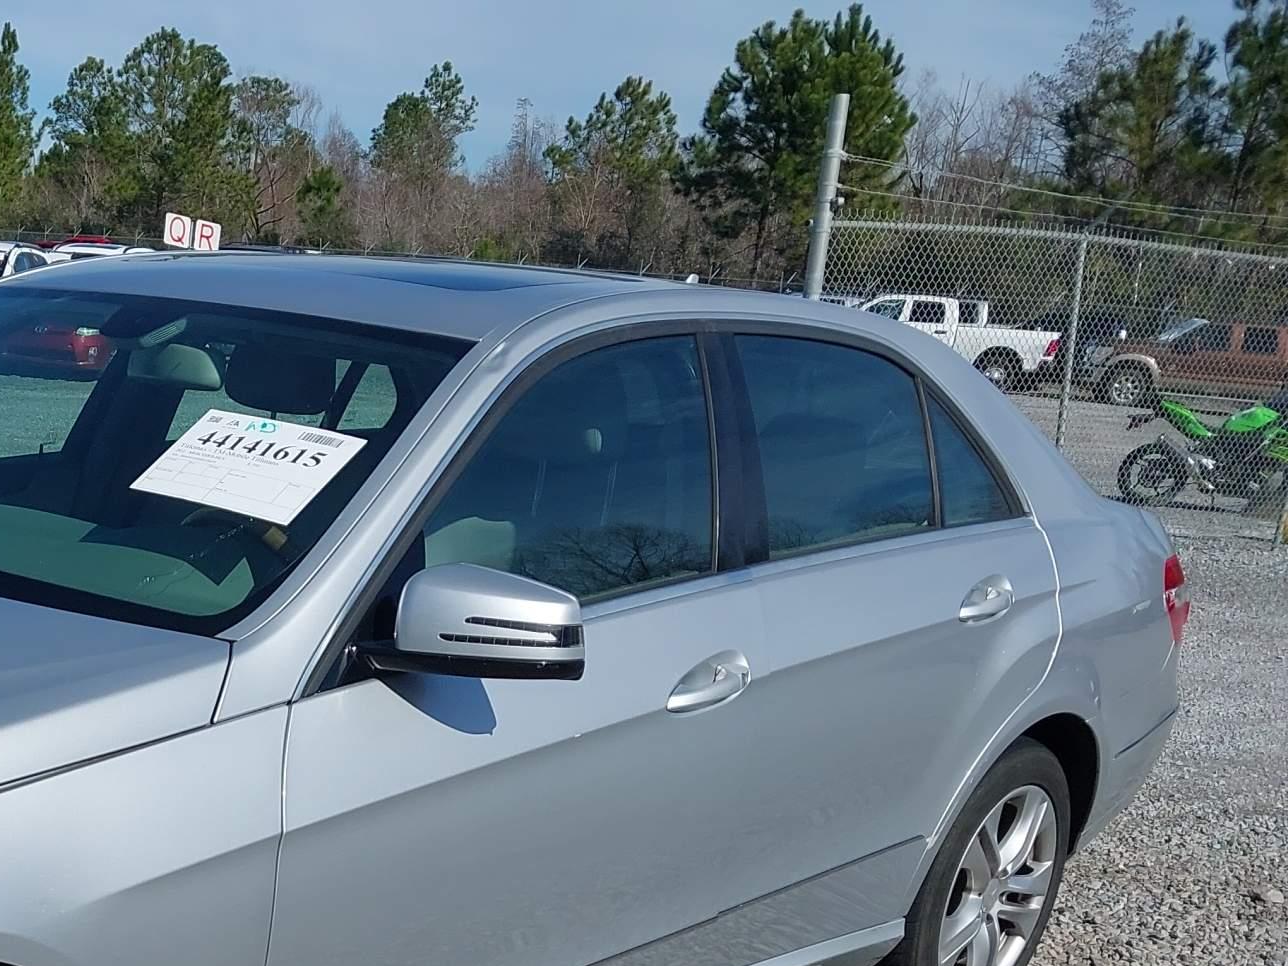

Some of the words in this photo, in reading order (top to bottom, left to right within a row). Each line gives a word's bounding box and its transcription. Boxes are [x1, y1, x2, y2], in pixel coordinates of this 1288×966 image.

[169, 216, 186, 245] Q
[198, 223, 214, 251] R
[197, 431, 328, 467] 44141615
